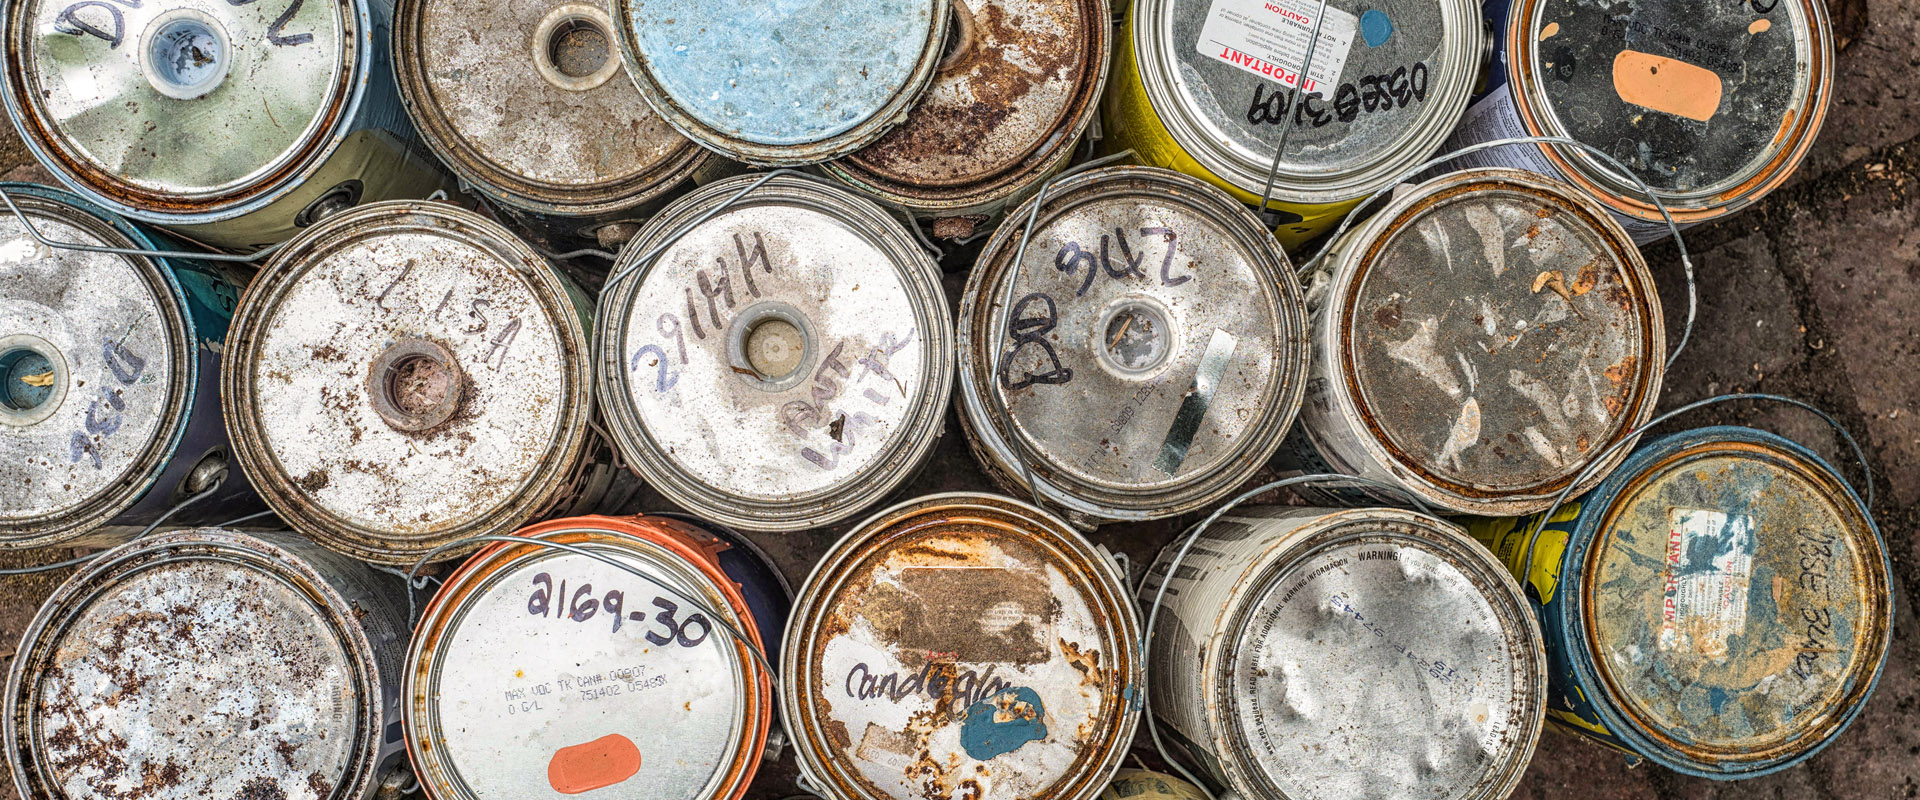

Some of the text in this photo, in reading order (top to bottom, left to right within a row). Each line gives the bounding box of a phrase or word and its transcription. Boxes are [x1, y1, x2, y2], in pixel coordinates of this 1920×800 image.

[1264, 2, 1310, 25] CAUTION
[1323, 33, 1337, 42] NOT
[1218, 47, 1317, 92] IMPORTANT
[1357, 550, 1402, 562] WARNING!
[1304, 557, 1349, 582] INFORMATION
[1279, 577, 1308, 604] WARNING
[528, 572, 712, 648] 2169-30
[1257, 601, 1285, 639] ADDITIONAL
[1329, 594, 1387, 638] 97445
[1253, 638, 1264, 653] FOR
[1250, 653, 1260, 674] LABEL
[504, 688, 526, 701] MAX
[531, 682, 552, 697] VOC
[557, 679, 572, 691] TK
[577, 673, 603, 688] CAN#
[580, 684, 621, 701] 751402
[1250, 676, 1258, 694] READ
[327, 675, 342, 723] WARNING!
[521, 700, 543, 712] G/L
